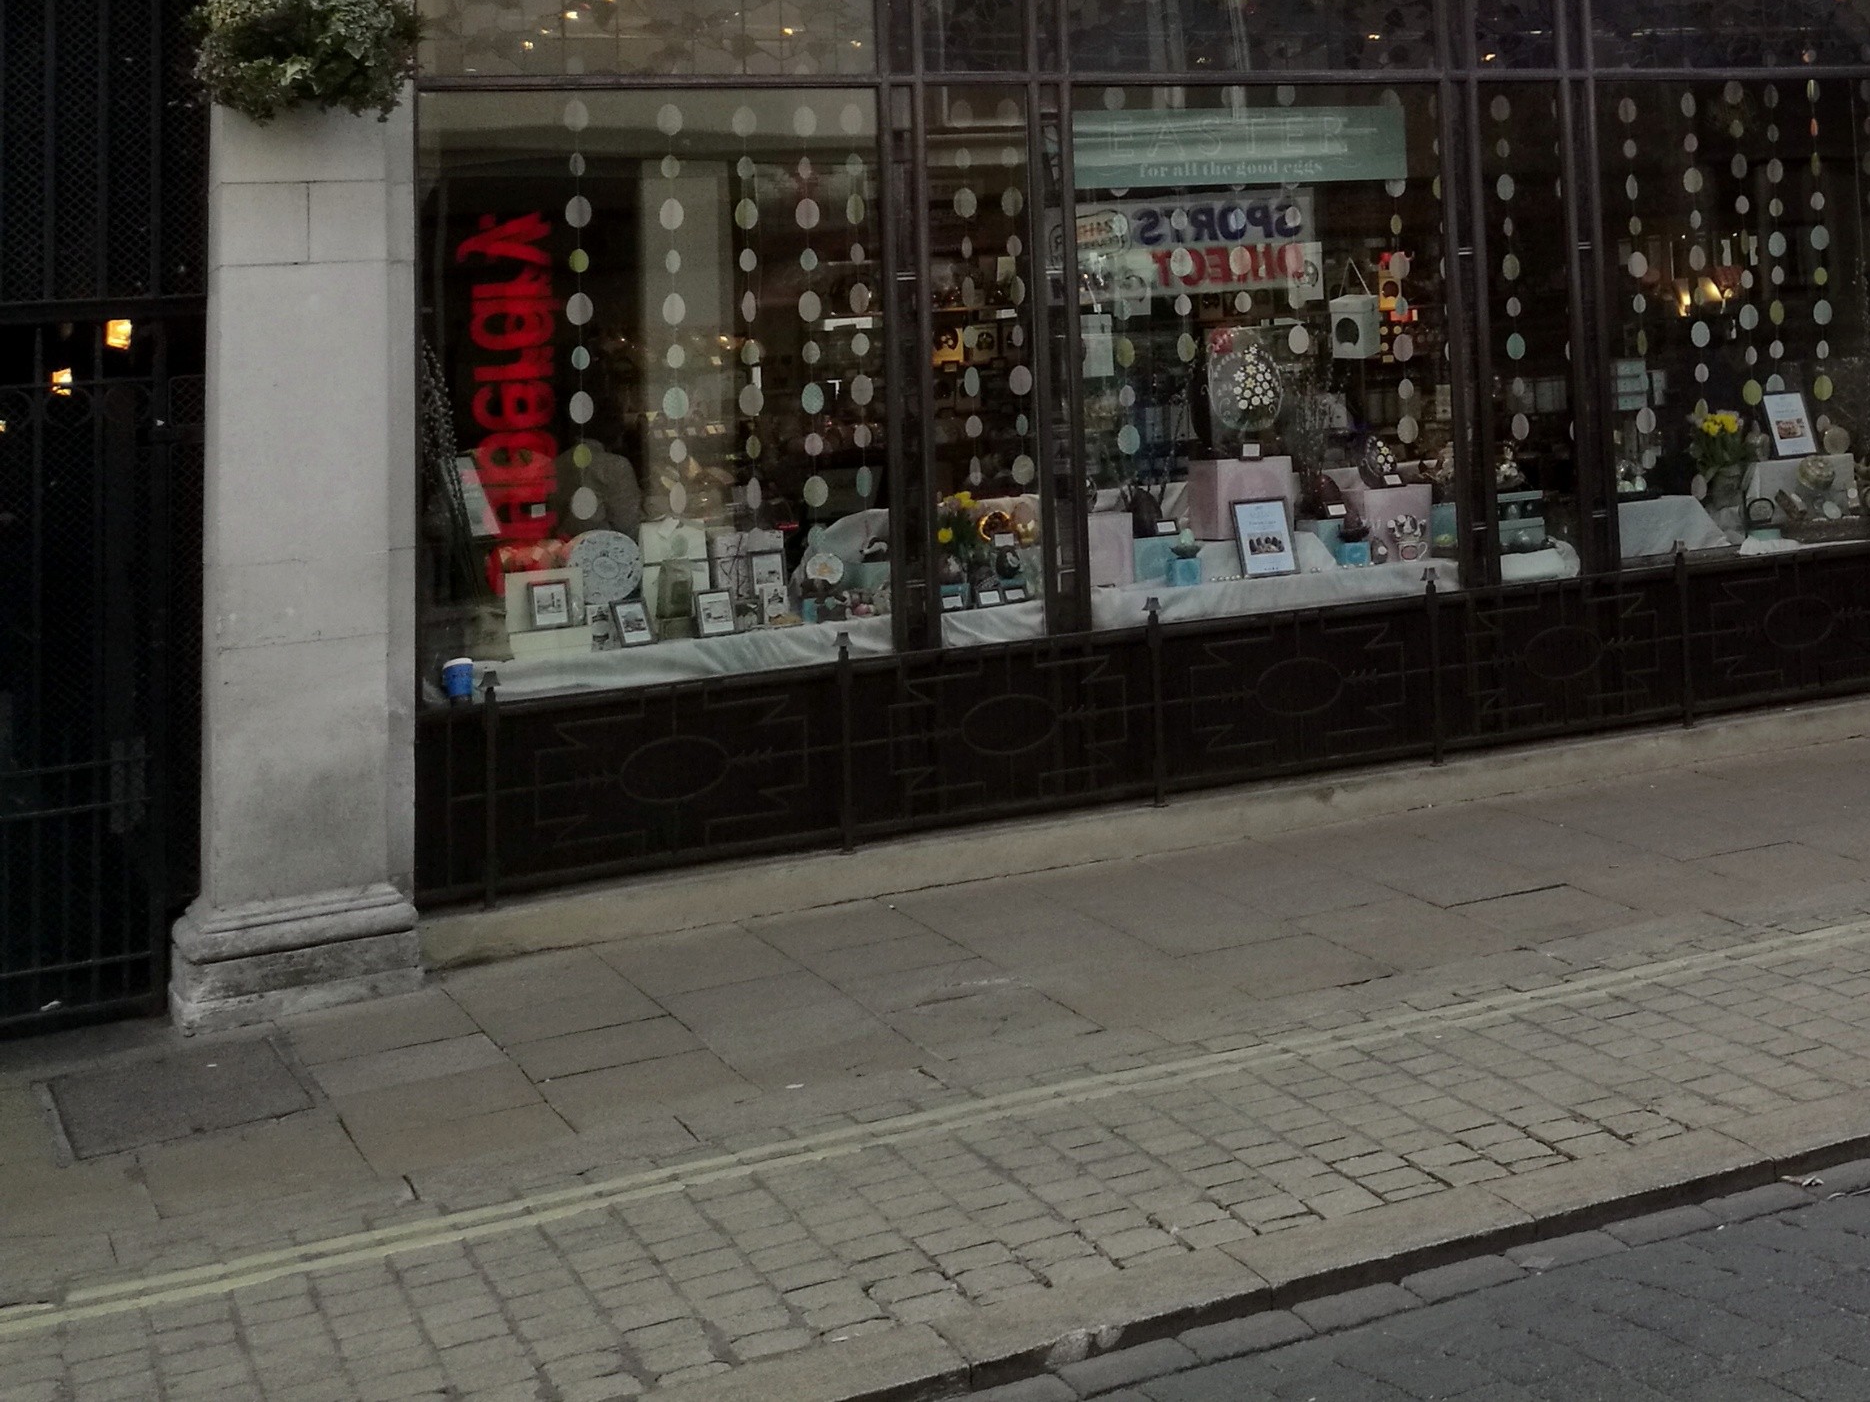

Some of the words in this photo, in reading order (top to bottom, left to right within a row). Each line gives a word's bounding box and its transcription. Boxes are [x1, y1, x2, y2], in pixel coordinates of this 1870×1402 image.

[1108, 113, 1347, 160] EASTER
[1139, 162, 1169, 179] for
[1172, 161, 1198, 178] all
[1201, 160, 1231, 177] the
[1234, 158, 1280, 178] good
[1283, 160, 1324, 176] eggs
